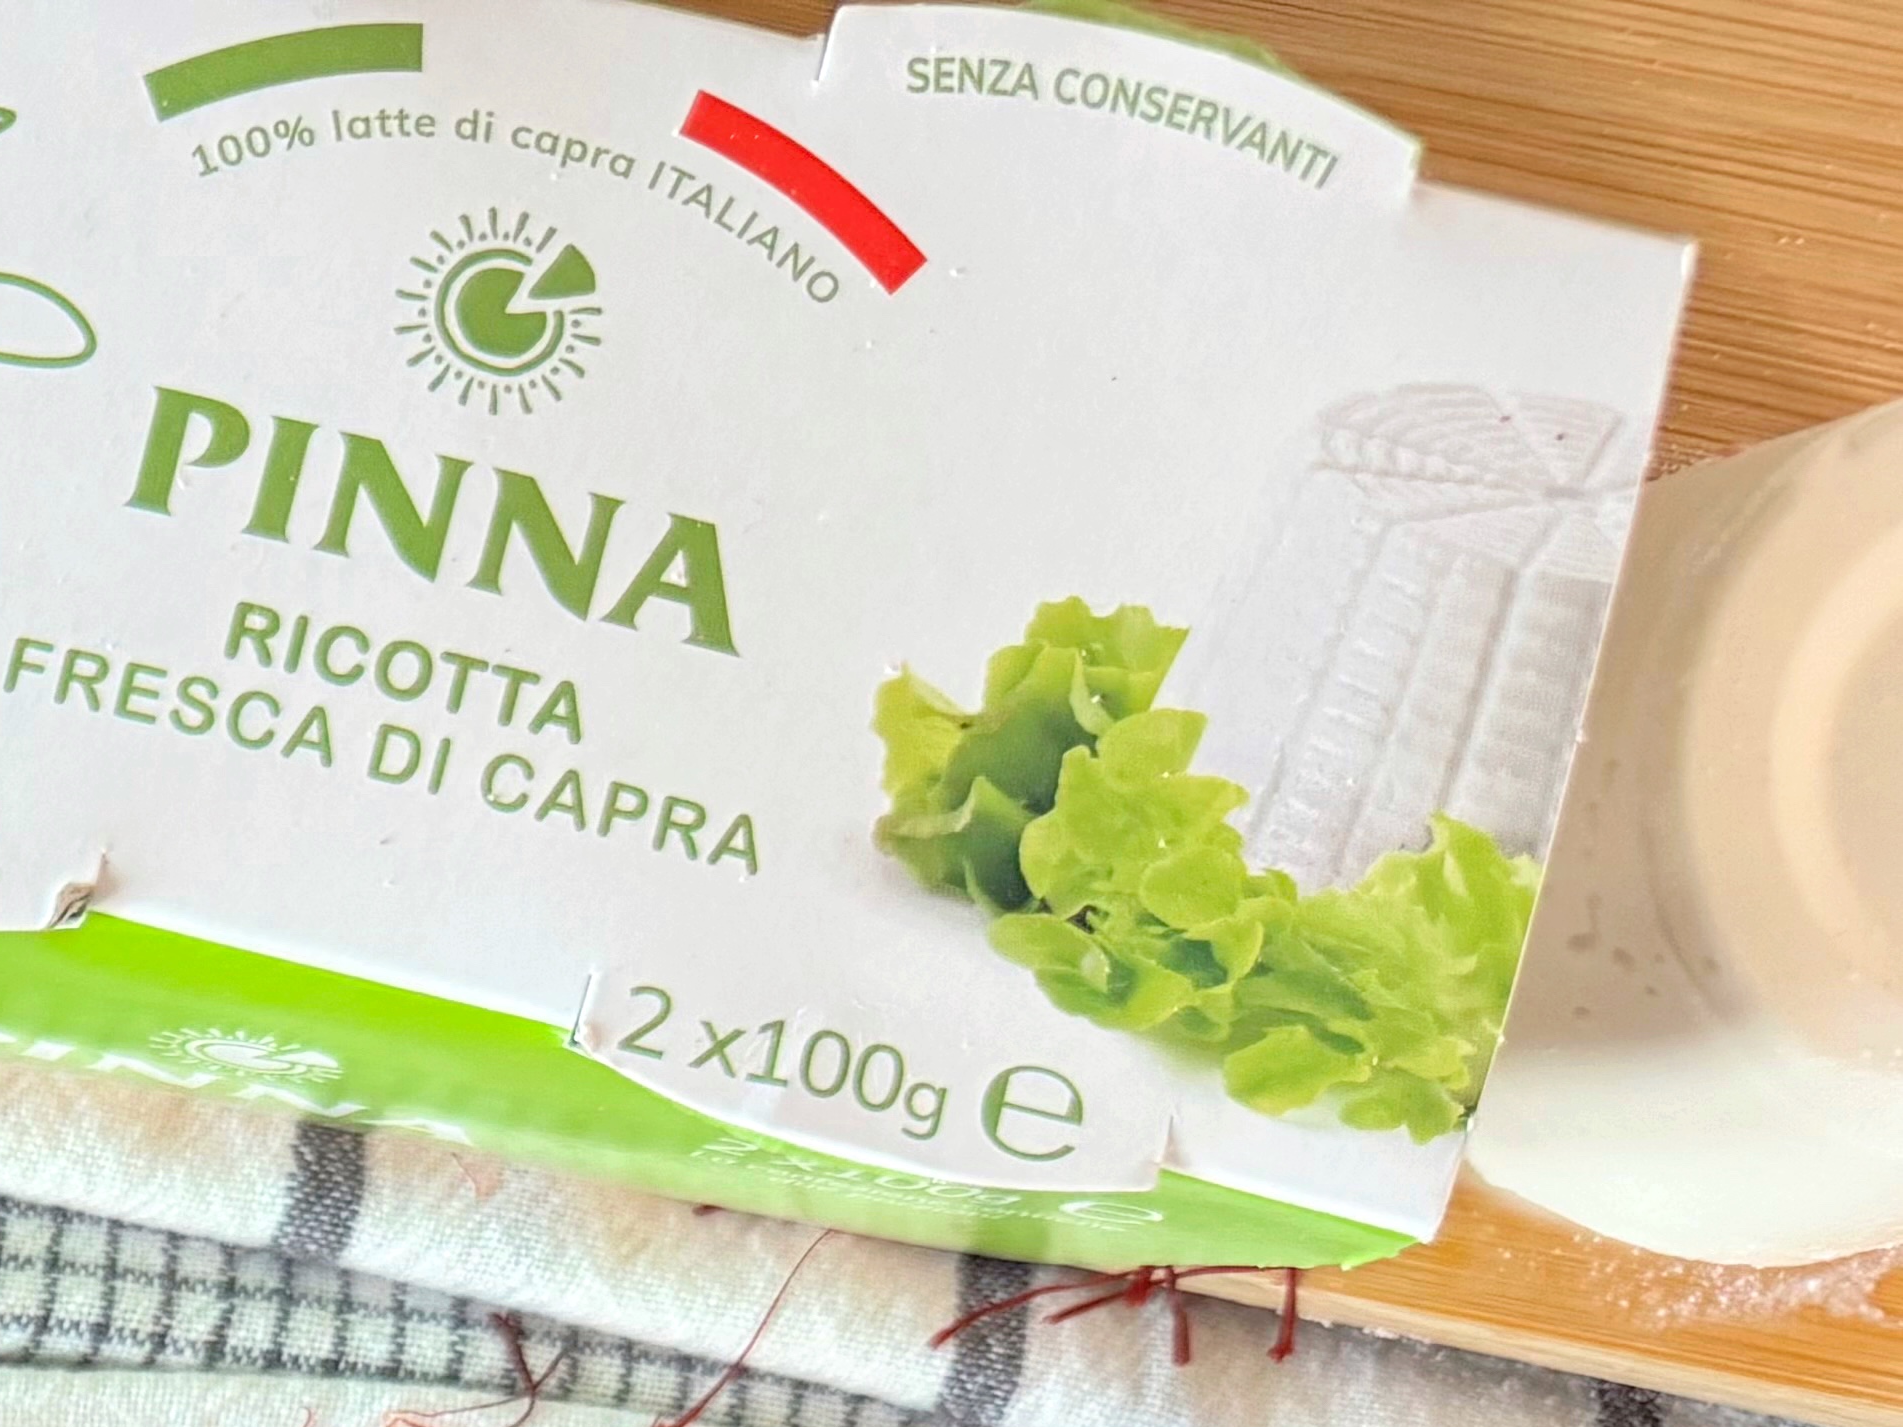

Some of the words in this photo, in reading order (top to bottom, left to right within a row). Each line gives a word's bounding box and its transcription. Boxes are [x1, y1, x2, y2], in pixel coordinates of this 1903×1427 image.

[191, 115, 316, 178] 100%
[332, 108, 437, 143] latte
[454, 108, 495, 143] di
[510, 122, 635, 180] capra
[647, 160, 841, 305] ITALIANO
[906, 55, 1039, 100] SENZA
[1053, 67, 1339, 190] CONSERVANTI
[124, 384, 740, 657] PINNA
[3, 637, 334, 768] FRESCA
[367, 722, 451, 795] DI
[480, 753, 759, 876] CAPRA
[223, 601, 584, 745] RICOTTA
[616, 985, 672, 1060] 2
[686, 1018, 949, 1141] x100g
